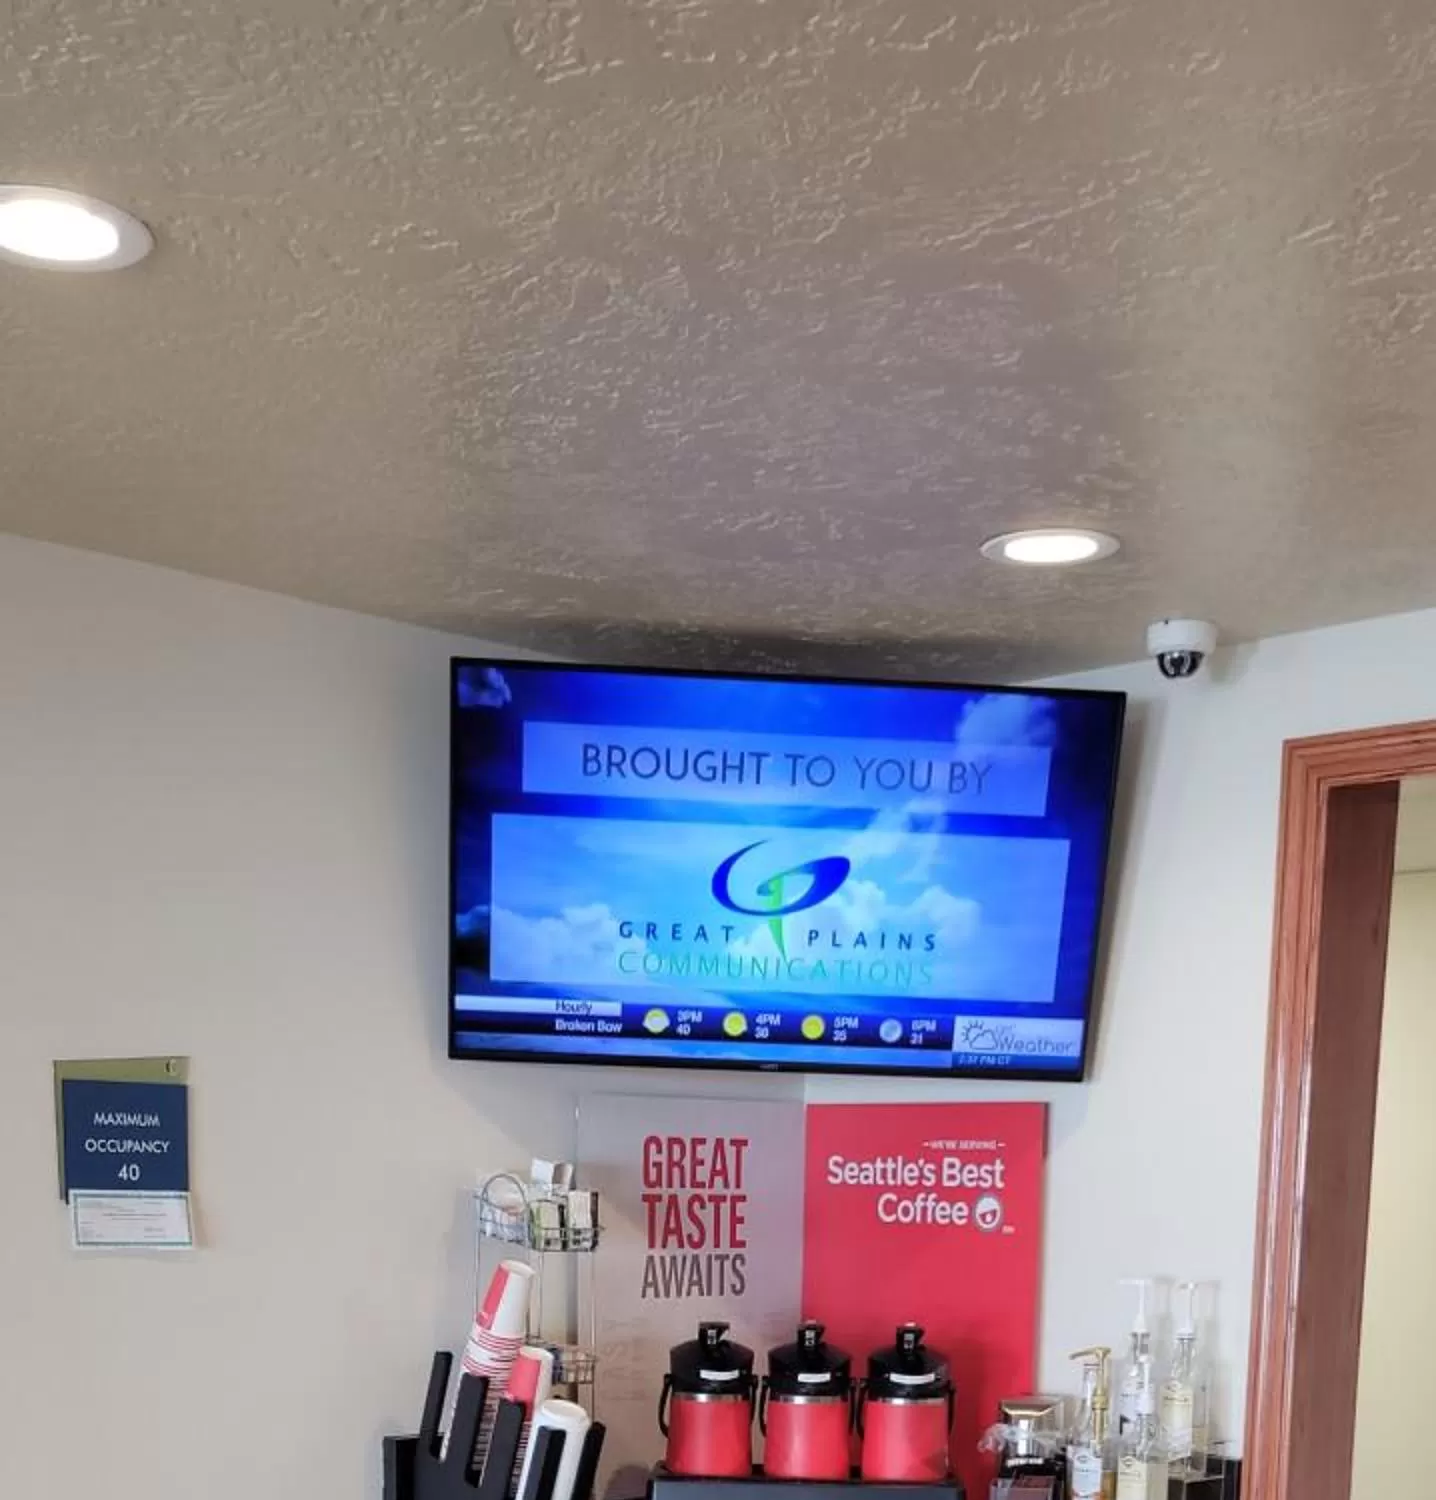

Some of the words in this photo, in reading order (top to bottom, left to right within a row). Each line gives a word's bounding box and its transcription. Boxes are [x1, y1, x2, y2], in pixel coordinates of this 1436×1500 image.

[581, 742, 771, 786] BROUGHT
[784, 753, 836, 788] TO
[854, 756, 934, 791] YOU
[947, 761, 993, 796] BY
[618, 921, 737, 945] GREAT
[807, 929, 937, 952] PLAINS
[617, 950, 935, 986] COMMUNICATIONS
[554, 999, 593, 1016] Hourly
[755, 1013, 781, 1026] 4PM
[554, 1018, 595, 1033] Broken
[597, 1019, 623, 1034] Bow
[1000, 1033, 1073, 1054] Weather
[93, 1112, 161, 1128] MAXIMUM
[84, 1138, 170, 1154] OCCUPANCY
[118, 1163, 141, 1182] 40
[643, 1135, 749, 1190] GREAT
[827, 1155, 938, 1188] Seattle's
[941, 1156, 1006, 1189] Best
[641, 1193, 748, 1250] TASTE
[876, 1192, 970, 1226] Coffee
[641, 1253, 747, 1299] AWAITS
